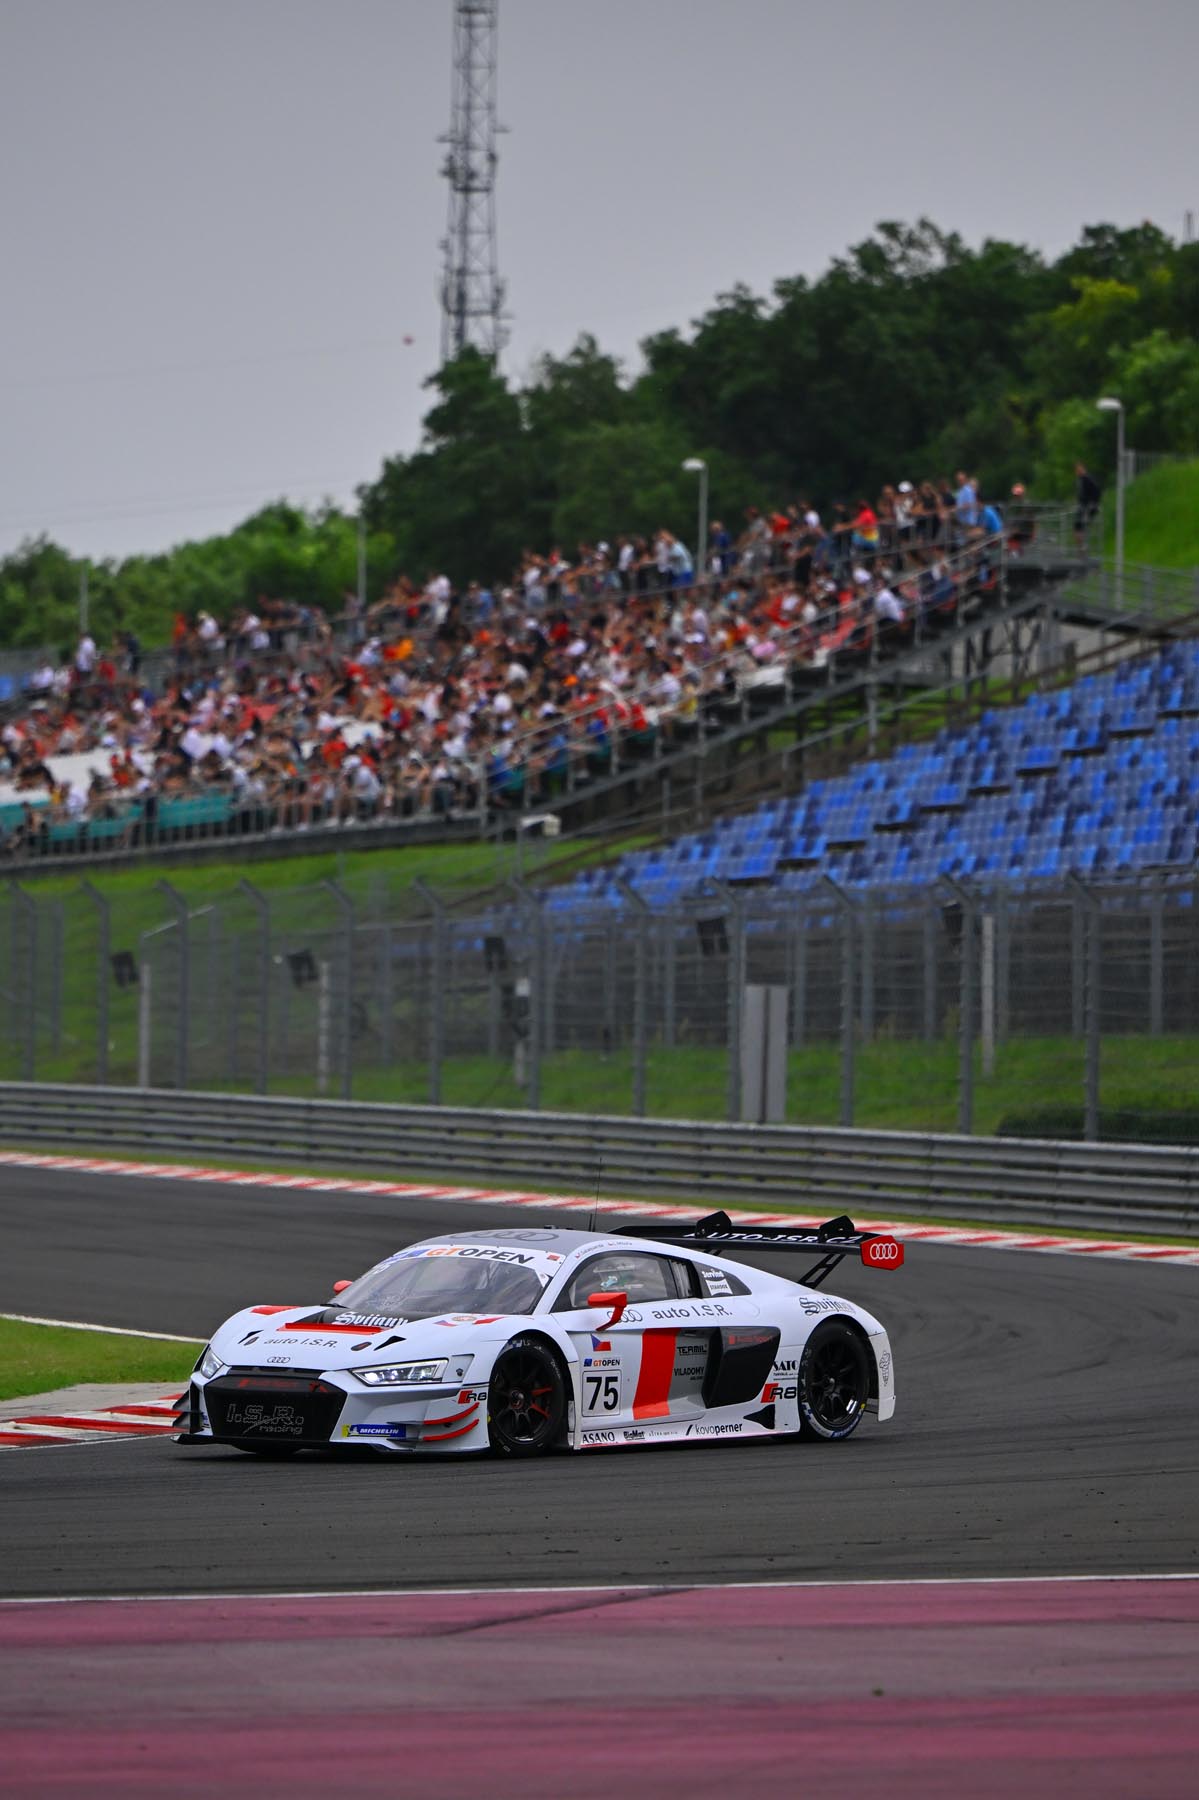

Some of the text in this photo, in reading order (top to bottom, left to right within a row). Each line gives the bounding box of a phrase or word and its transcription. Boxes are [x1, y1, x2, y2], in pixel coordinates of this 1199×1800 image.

[652, 1304, 733, 1319] auto I.S.R.
[300, 1338, 338, 1348] I.S.R.
[465, 1392, 487, 1402] R8
[586, 1376, 619, 1411] 75
[769, 1386, 797, 1400] R8
[259, 1425, 303, 1435] racing
[695, 1423, 743, 1436] kovoperner
[582, 1431, 615, 1444] ASANO
